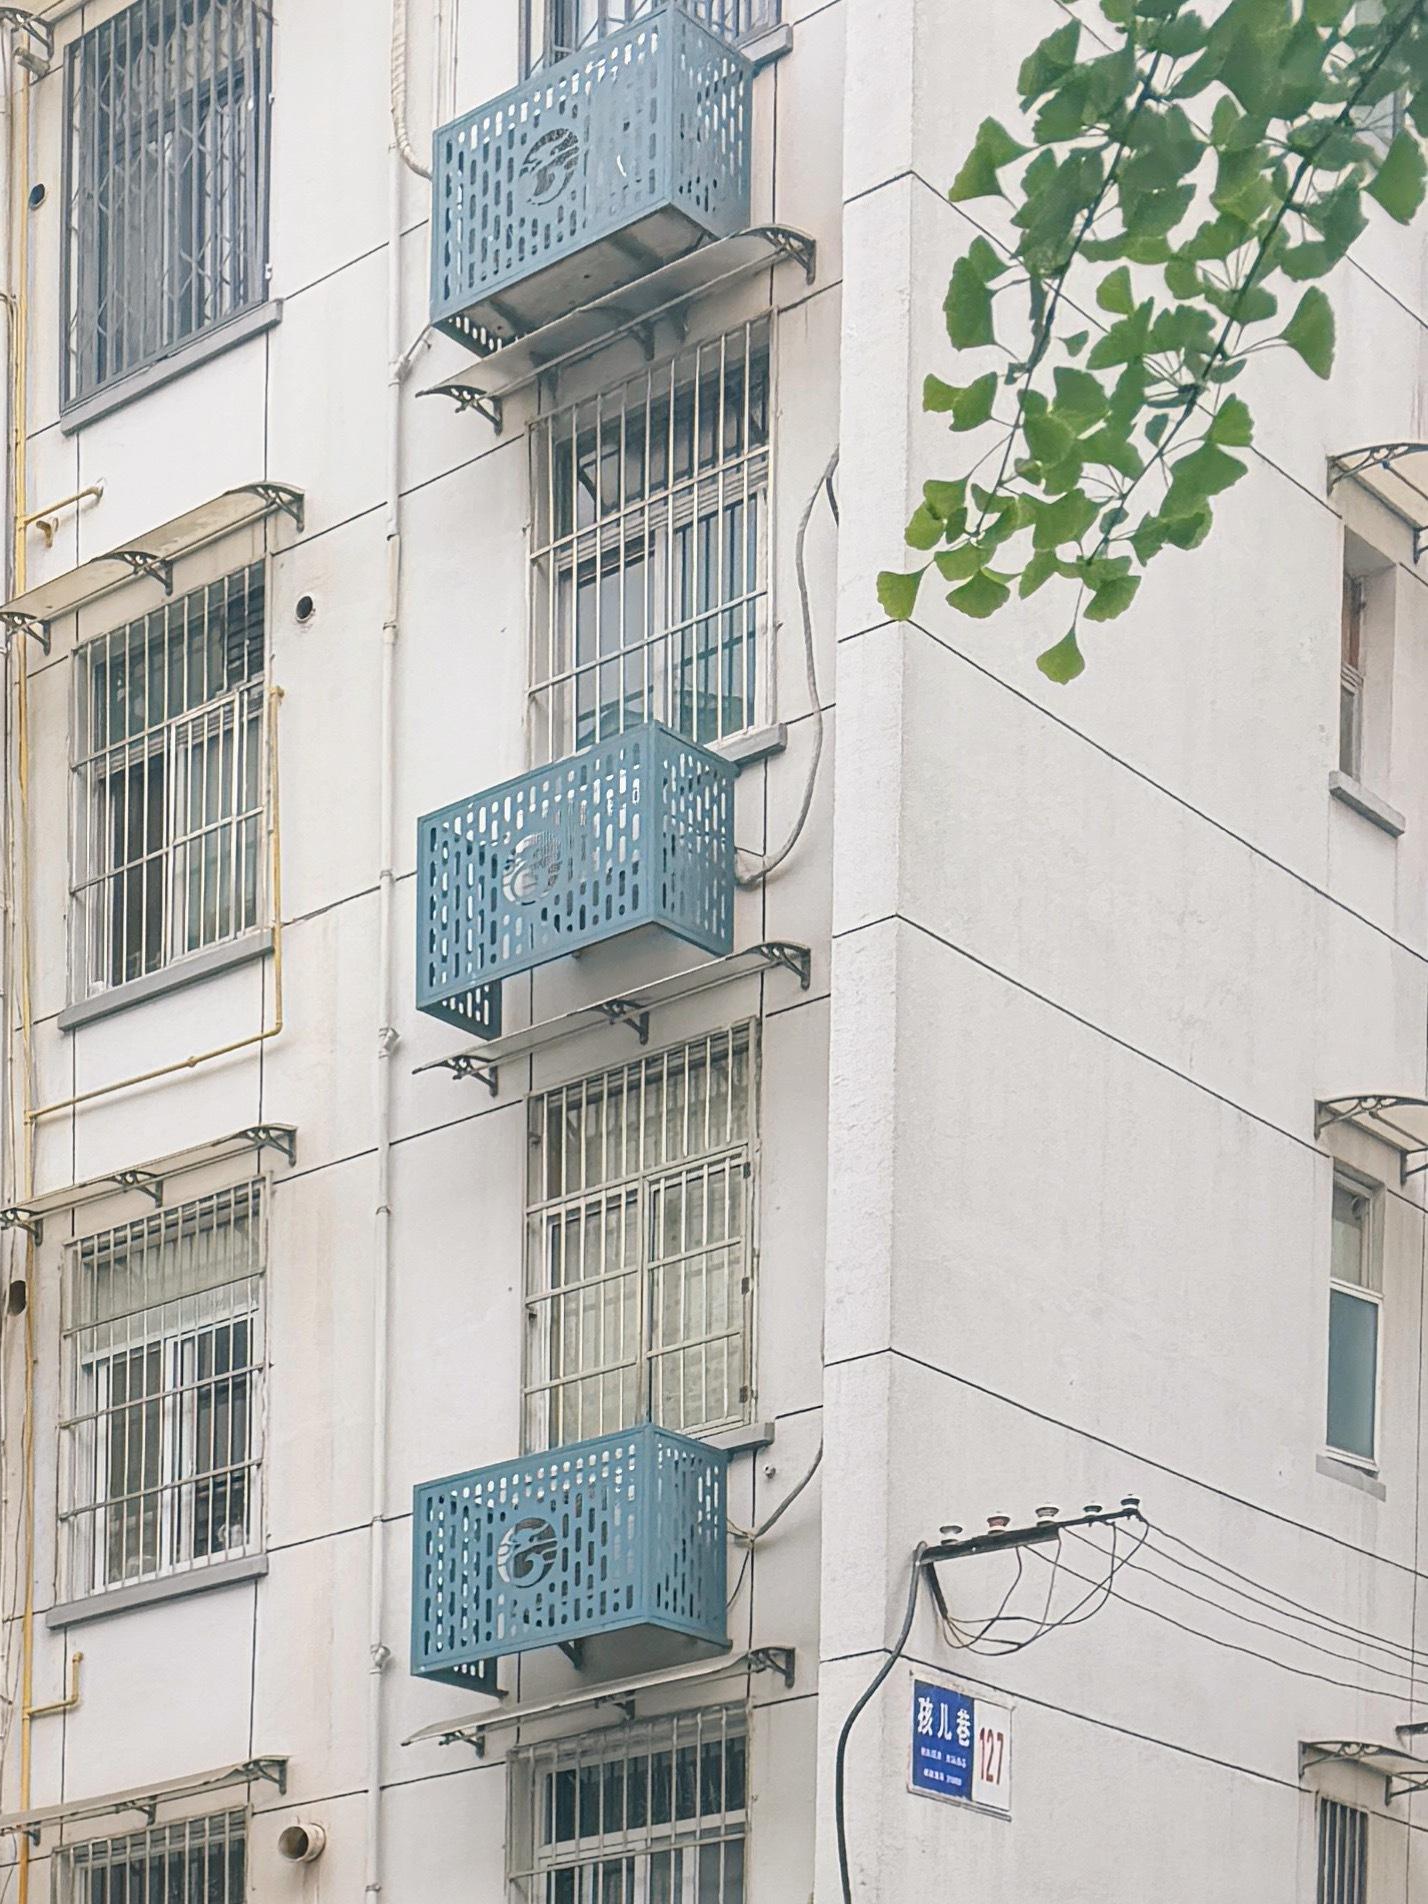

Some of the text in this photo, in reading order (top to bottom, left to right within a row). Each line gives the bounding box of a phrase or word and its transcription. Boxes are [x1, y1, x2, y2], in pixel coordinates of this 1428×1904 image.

[917, 1696, 971, 1747] 孩儿巷
[979, 1727, 1004, 1785] 127
